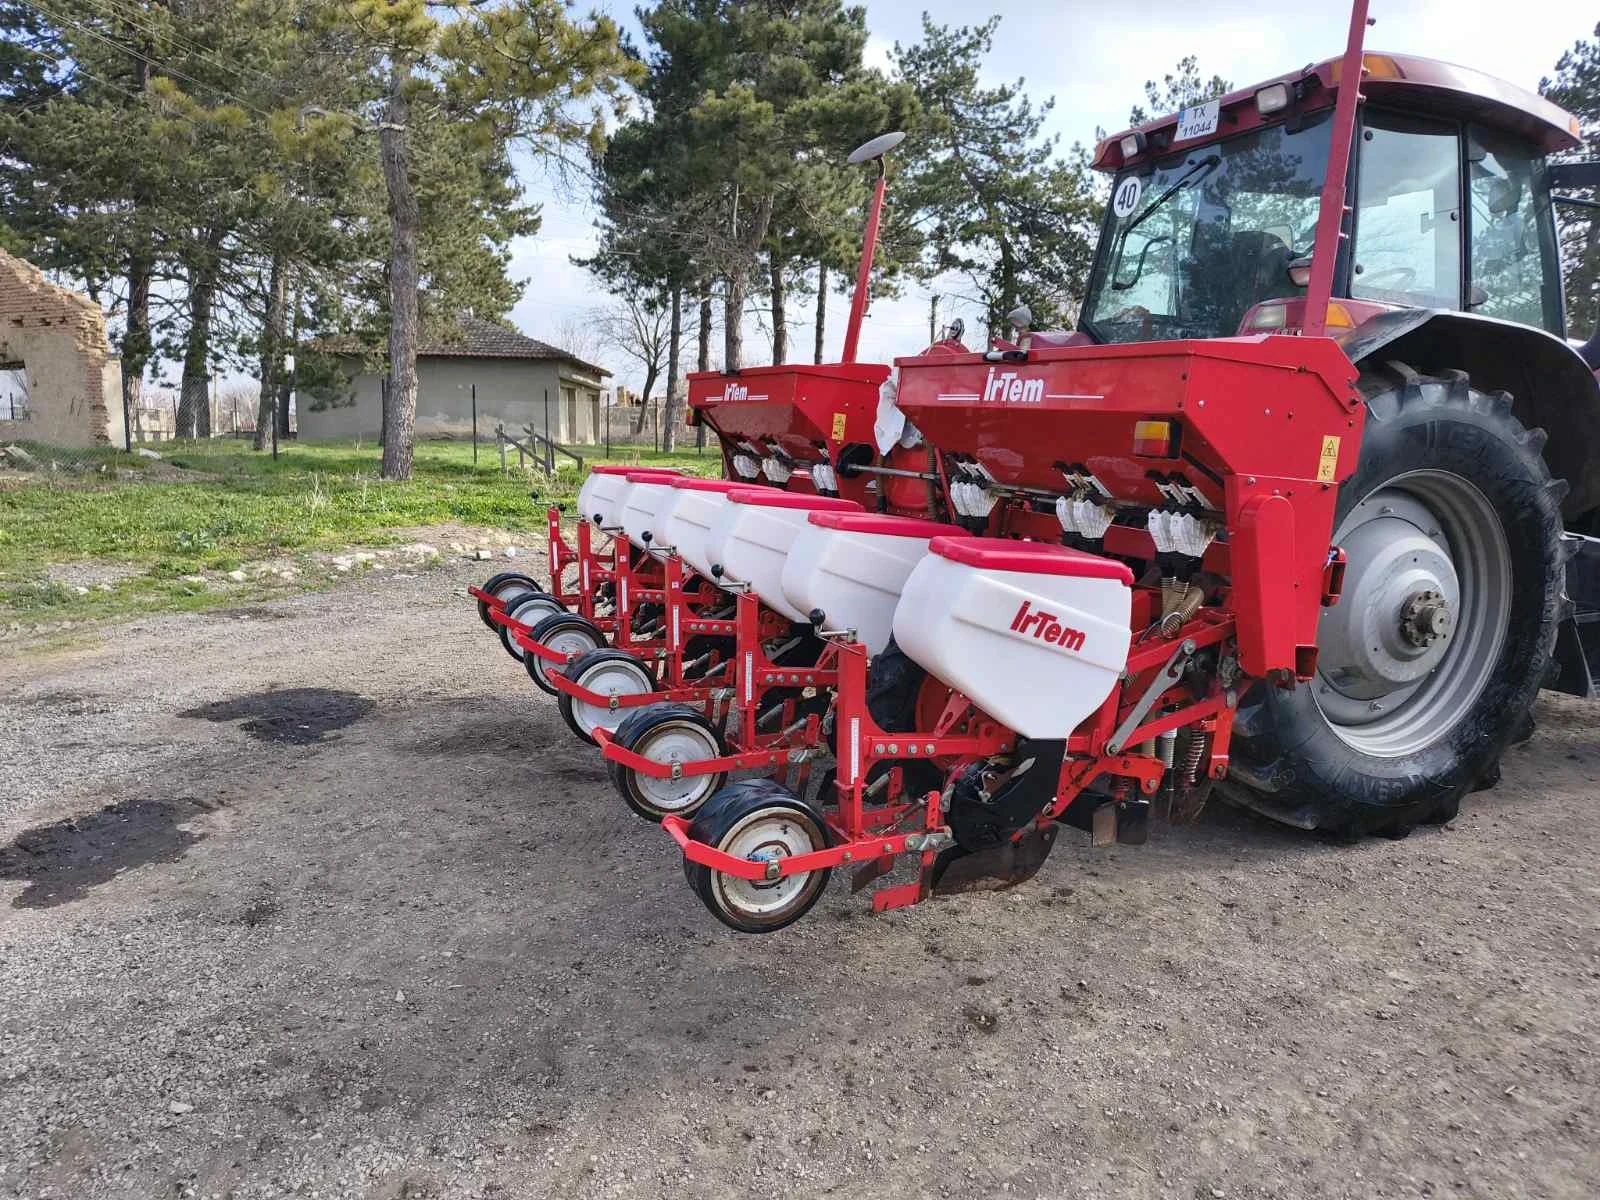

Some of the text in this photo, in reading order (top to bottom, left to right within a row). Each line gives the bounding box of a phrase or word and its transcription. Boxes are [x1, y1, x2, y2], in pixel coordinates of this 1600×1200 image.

[1193, 106, 1206, 120] TX
[1183, 120, 1212, 137] 11044
[1117, 183, 1137, 211] 40
